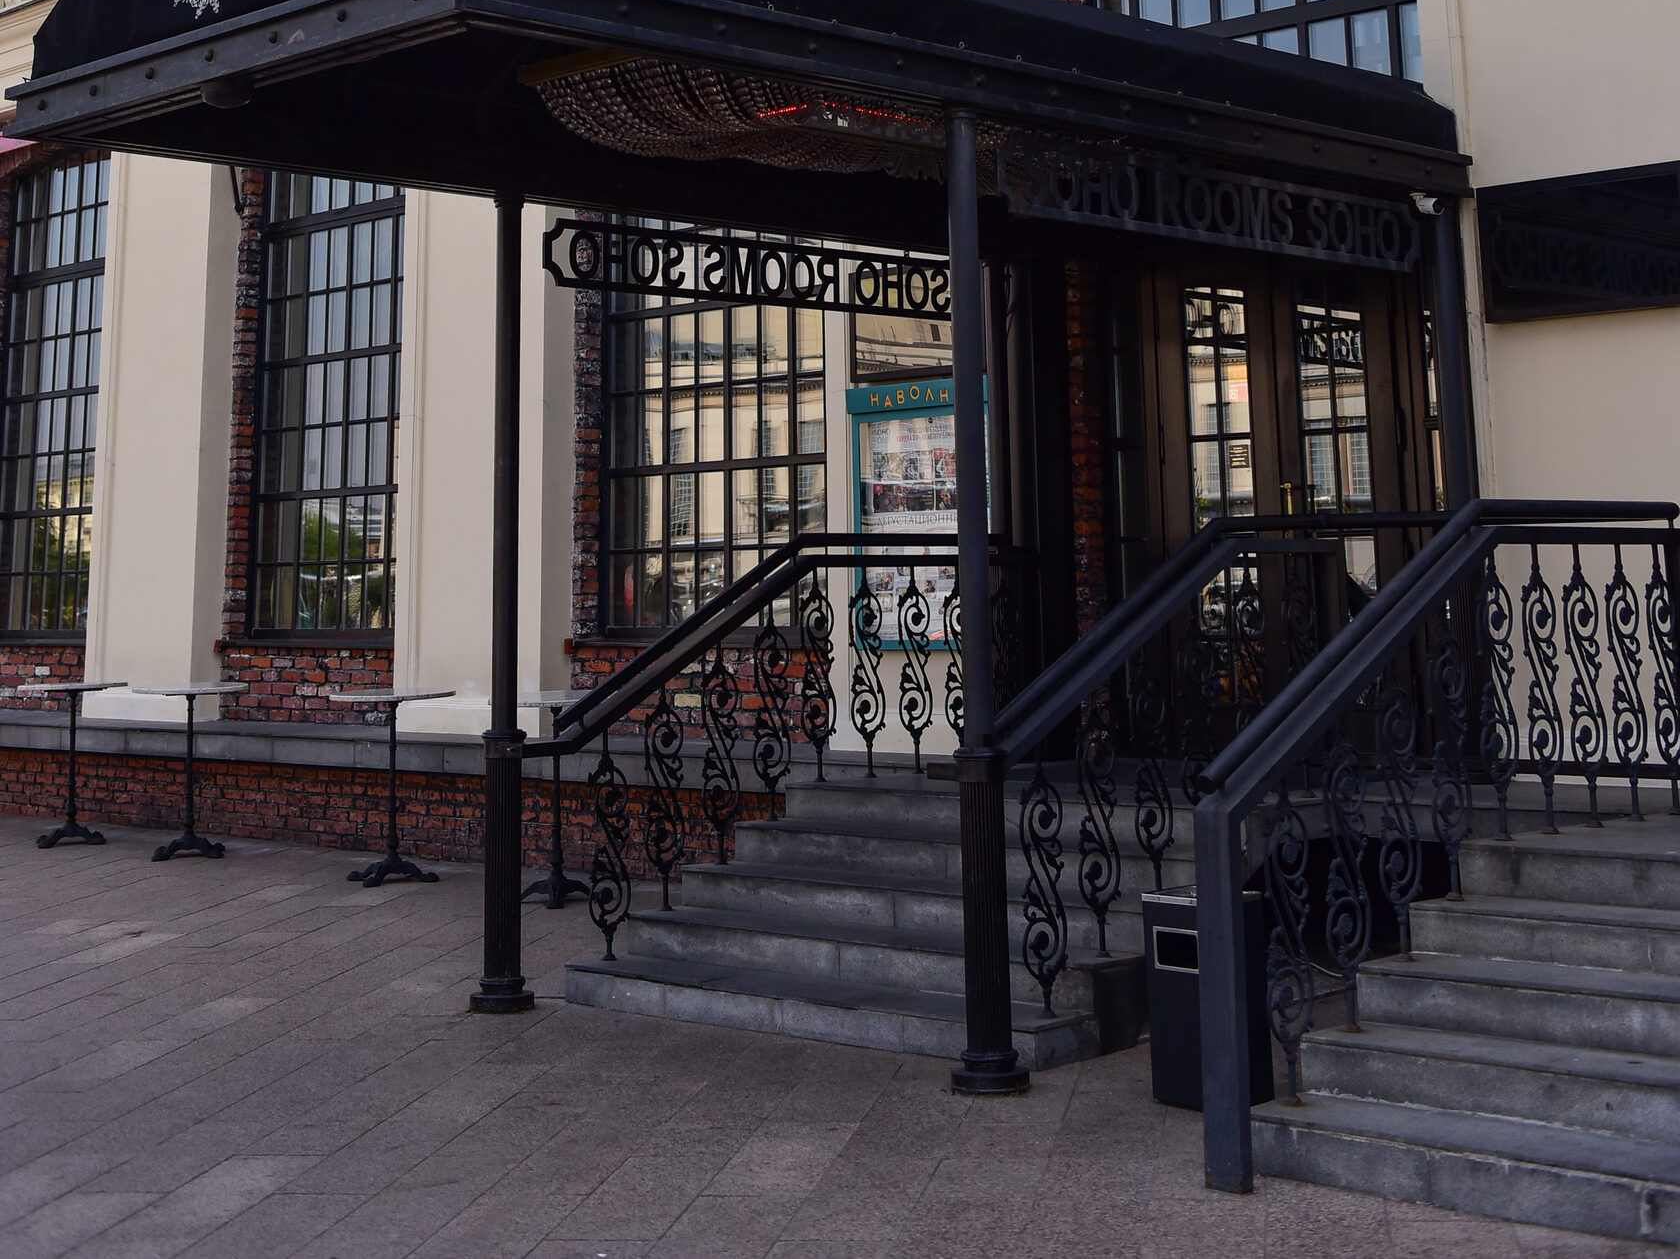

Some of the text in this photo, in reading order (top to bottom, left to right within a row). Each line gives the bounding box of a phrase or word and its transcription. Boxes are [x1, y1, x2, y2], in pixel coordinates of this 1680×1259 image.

[1022, 155, 1401, 261] SOHO ROOMS SOHO
